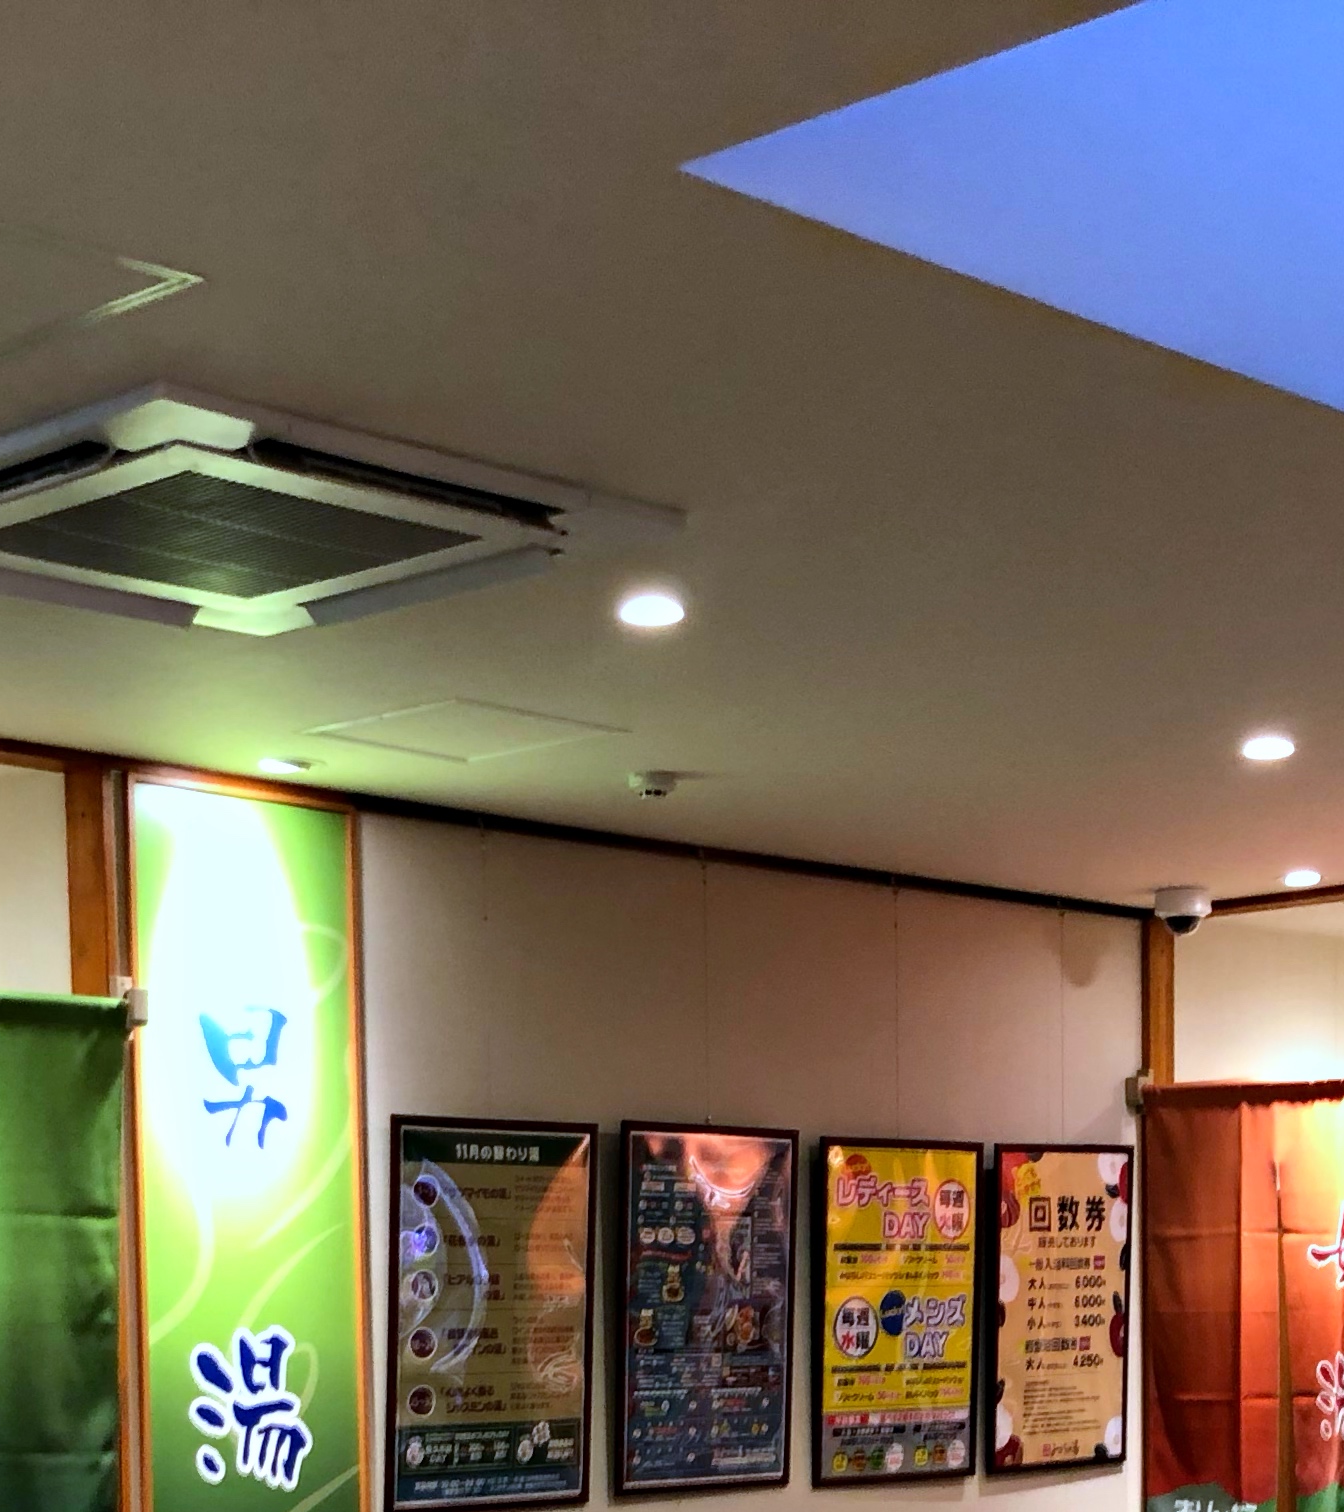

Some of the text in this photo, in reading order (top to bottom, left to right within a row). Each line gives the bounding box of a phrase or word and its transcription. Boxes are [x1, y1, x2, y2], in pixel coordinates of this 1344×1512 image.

[836, 1174, 931, 1208] レディース
[882, 1210, 931, 1240] DAY
[1029, 1195, 1105, 1232] 回数券
[905, 1293, 967, 1327] メンズ
[905, 1331, 948, 1358] DAY
